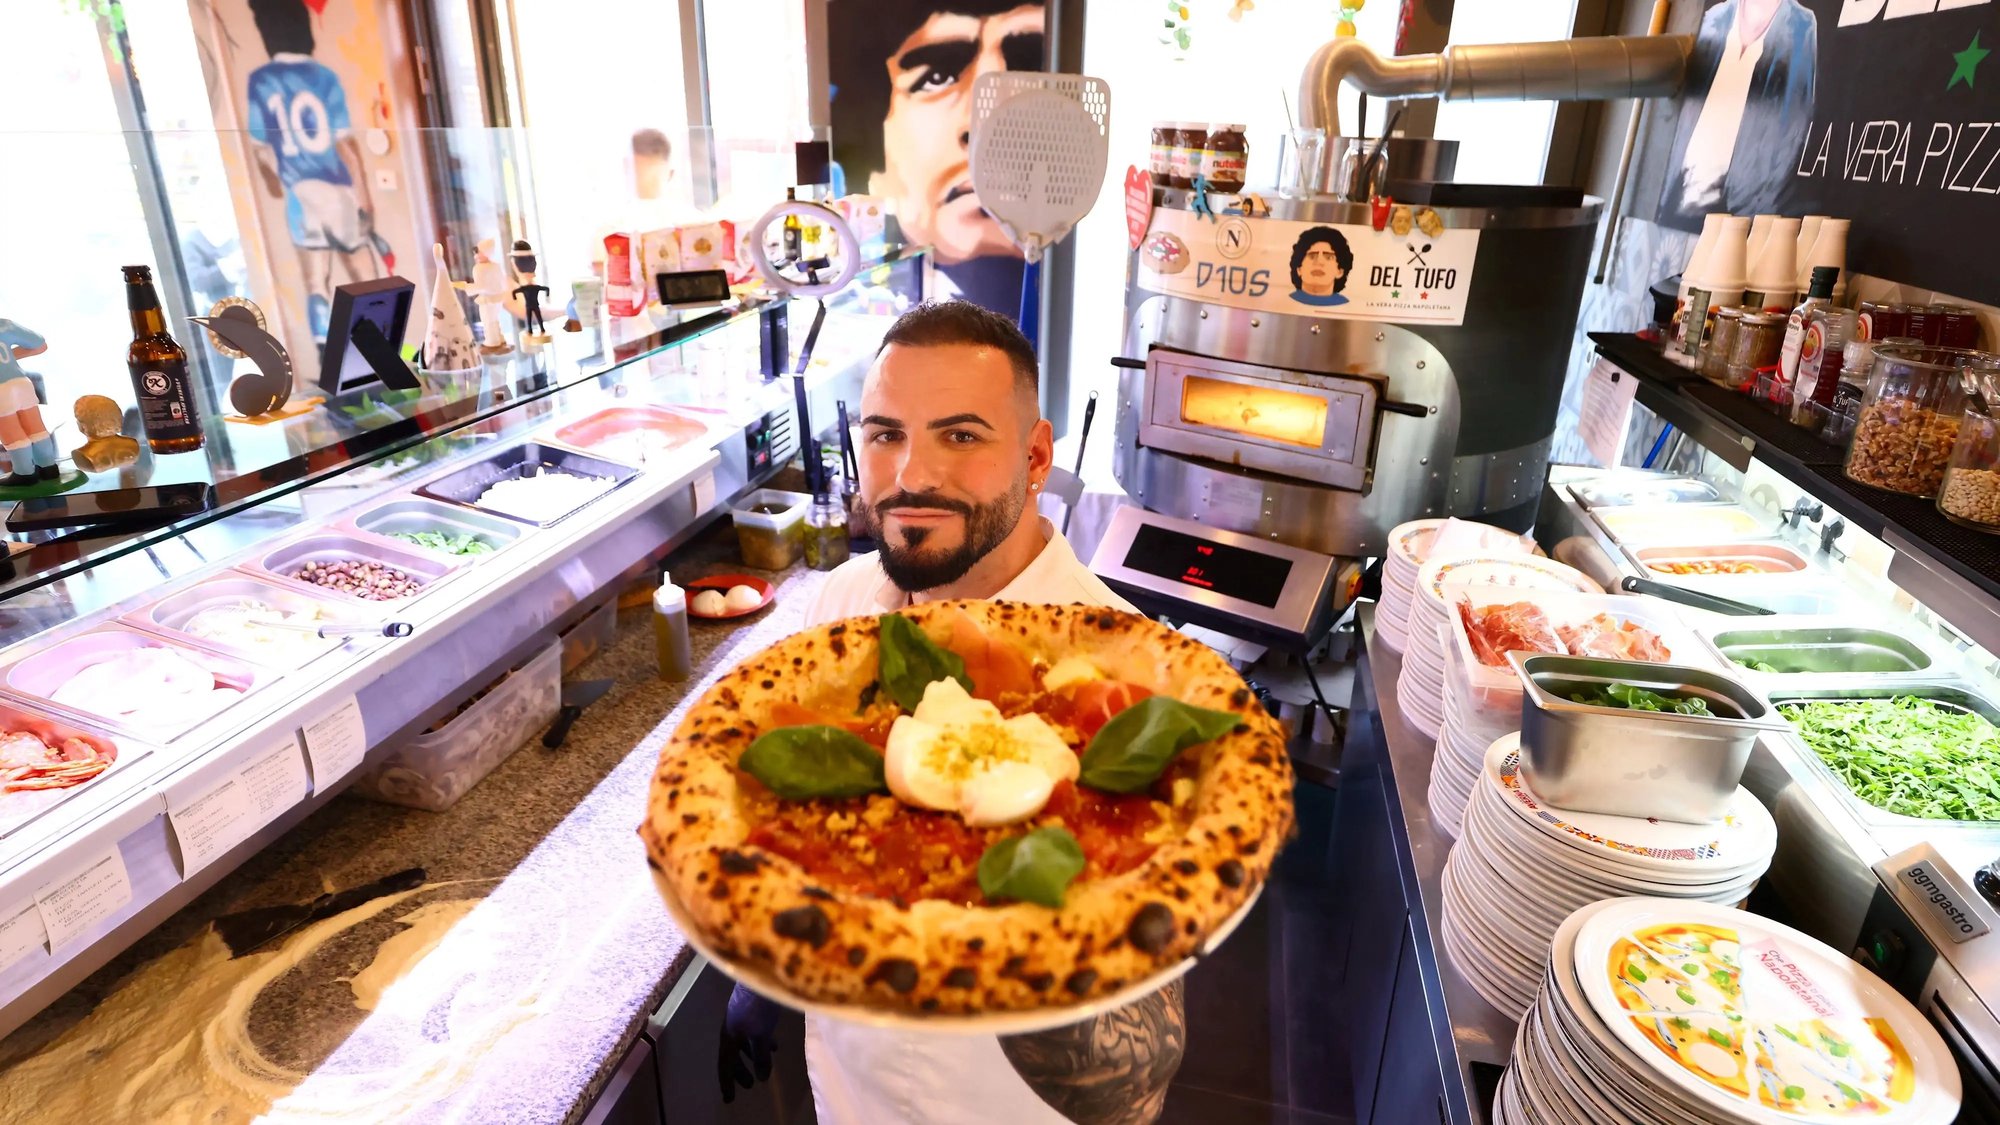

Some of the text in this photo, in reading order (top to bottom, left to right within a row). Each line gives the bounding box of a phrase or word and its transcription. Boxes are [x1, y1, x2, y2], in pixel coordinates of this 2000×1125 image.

[267, 89, 331, 156] 10
[1797, 120, 2000, 194] LA VERA PIZZ
[1225, 229, 1242, 248] N
[1370, 266, 1456, 289] DEL TUFO
[1908, 867, 1974, 933] ggmgastro
[1768, 949, 1785, 963] Che
[1783, 963, 1812, 987] Pizza
